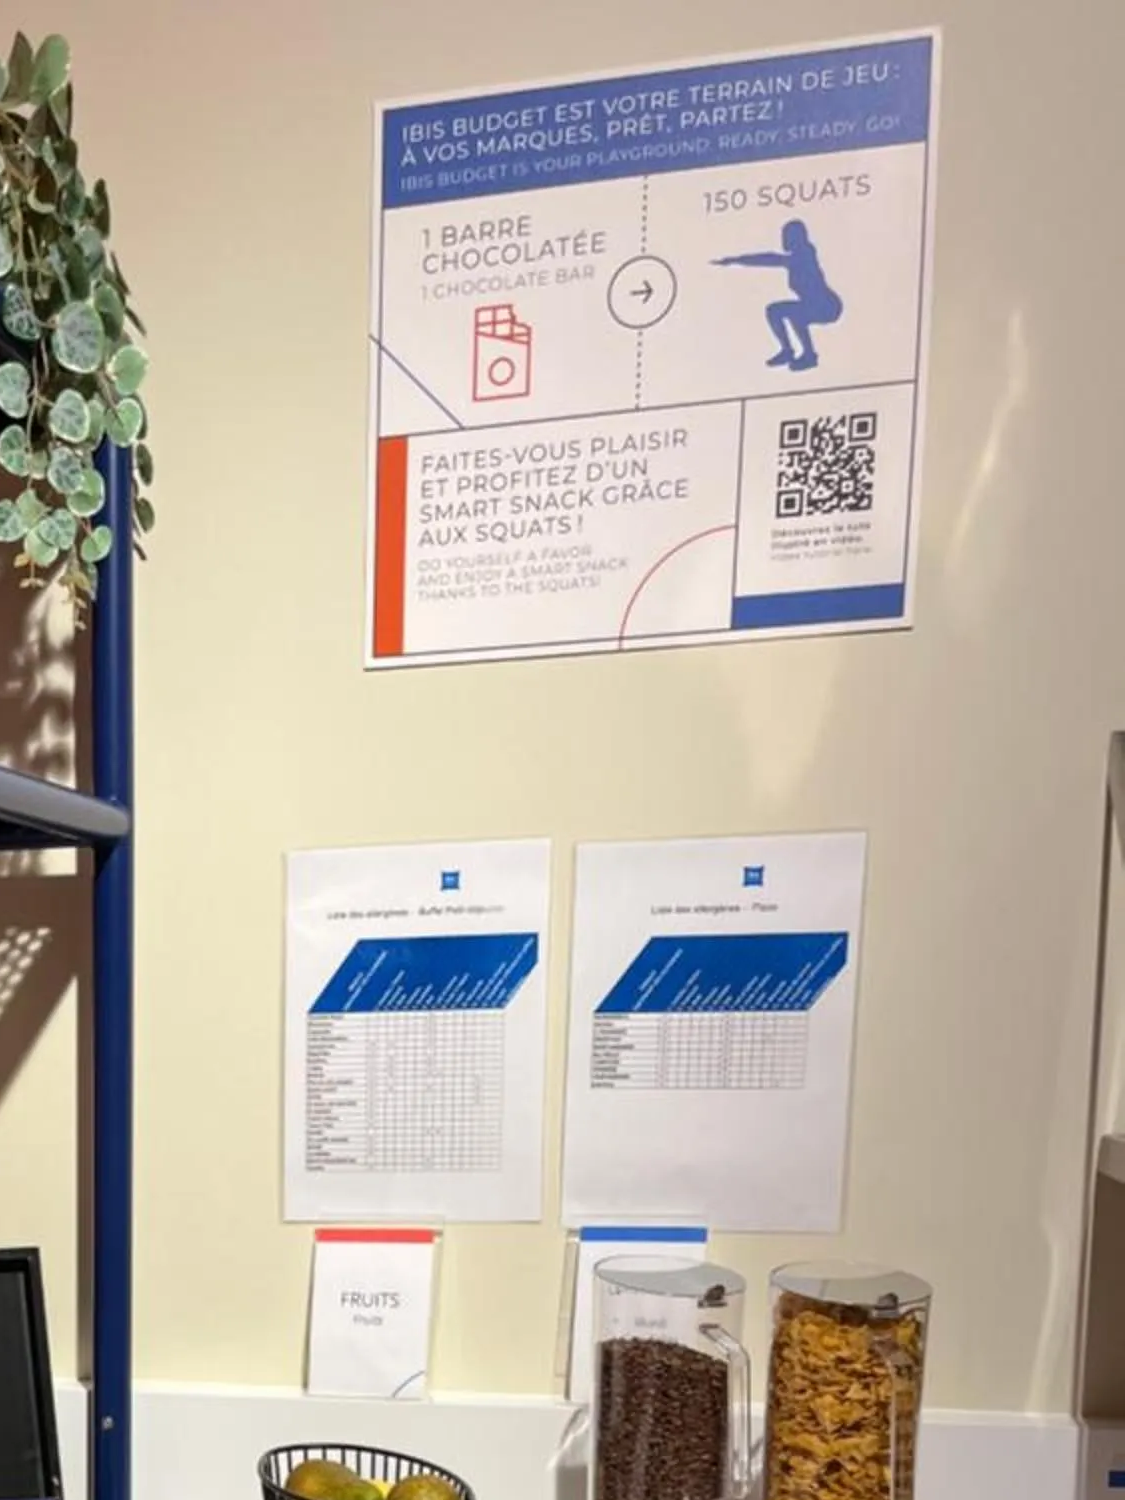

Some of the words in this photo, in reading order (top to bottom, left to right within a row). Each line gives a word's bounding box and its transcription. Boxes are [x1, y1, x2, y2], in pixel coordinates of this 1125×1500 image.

[402, 120, 445, 143] IBIS
[452, 106, 547, 137] BUDGET
[555, 100, 595, 123] EST
[603, 89, 680, 115] VOTRE
[689, 74, 792, 104] TERRAIN
[802, 70, 835, 91] DE
[423, 141, 470, 164] VOS
[400, 173, 433, 191] IBIS
[438, 164, 508, 187] BUDGET
[513, 163, 528, 177] IS
[533, 155, 581, 173] YOUR
[703, 188, 747, 214] 150
[757, 174, 871, 207] SQUATS
[422, 228, 430, 249] 1
[442, 215, 532, 247] BARRE
[423, 230, 606, 274] CHOCOLATÉE
[421, 285, 428, 300] 1
[433, 270, 550, 299] CHOCOLATE
[555, 265, 595, 284] BAR
[422, 440, 581, 474] FAITES-VOUS
[591, 429, 688, 456] PLAISIR
[421, 478, 449, 499] ET
[457, 465, 576, 495] PROFITEZ
[419, 498, 501, 524] SMART
[510, 490, 594, 515] SNACK
[602, 478, 689, 505] GRÂCE
[419, 525, 468, 547] AUX
[417, 573, 450, 586] AND
[455, 568, 502, 584] ENJOY
[507, 567, 520, 578] A
[523, 563, 571, 578] SMART
[576, 557, 628, 573] SNACK
[446, 551, 522, 570] YOURSELF
[528, 550, 538, 561] A
[417, 586, 476, 601] THANKS
[481, 584, 501, 596] TO
[505, 581, 535, 594] THE
[341, 1291, 400, 1309] FRUITS
